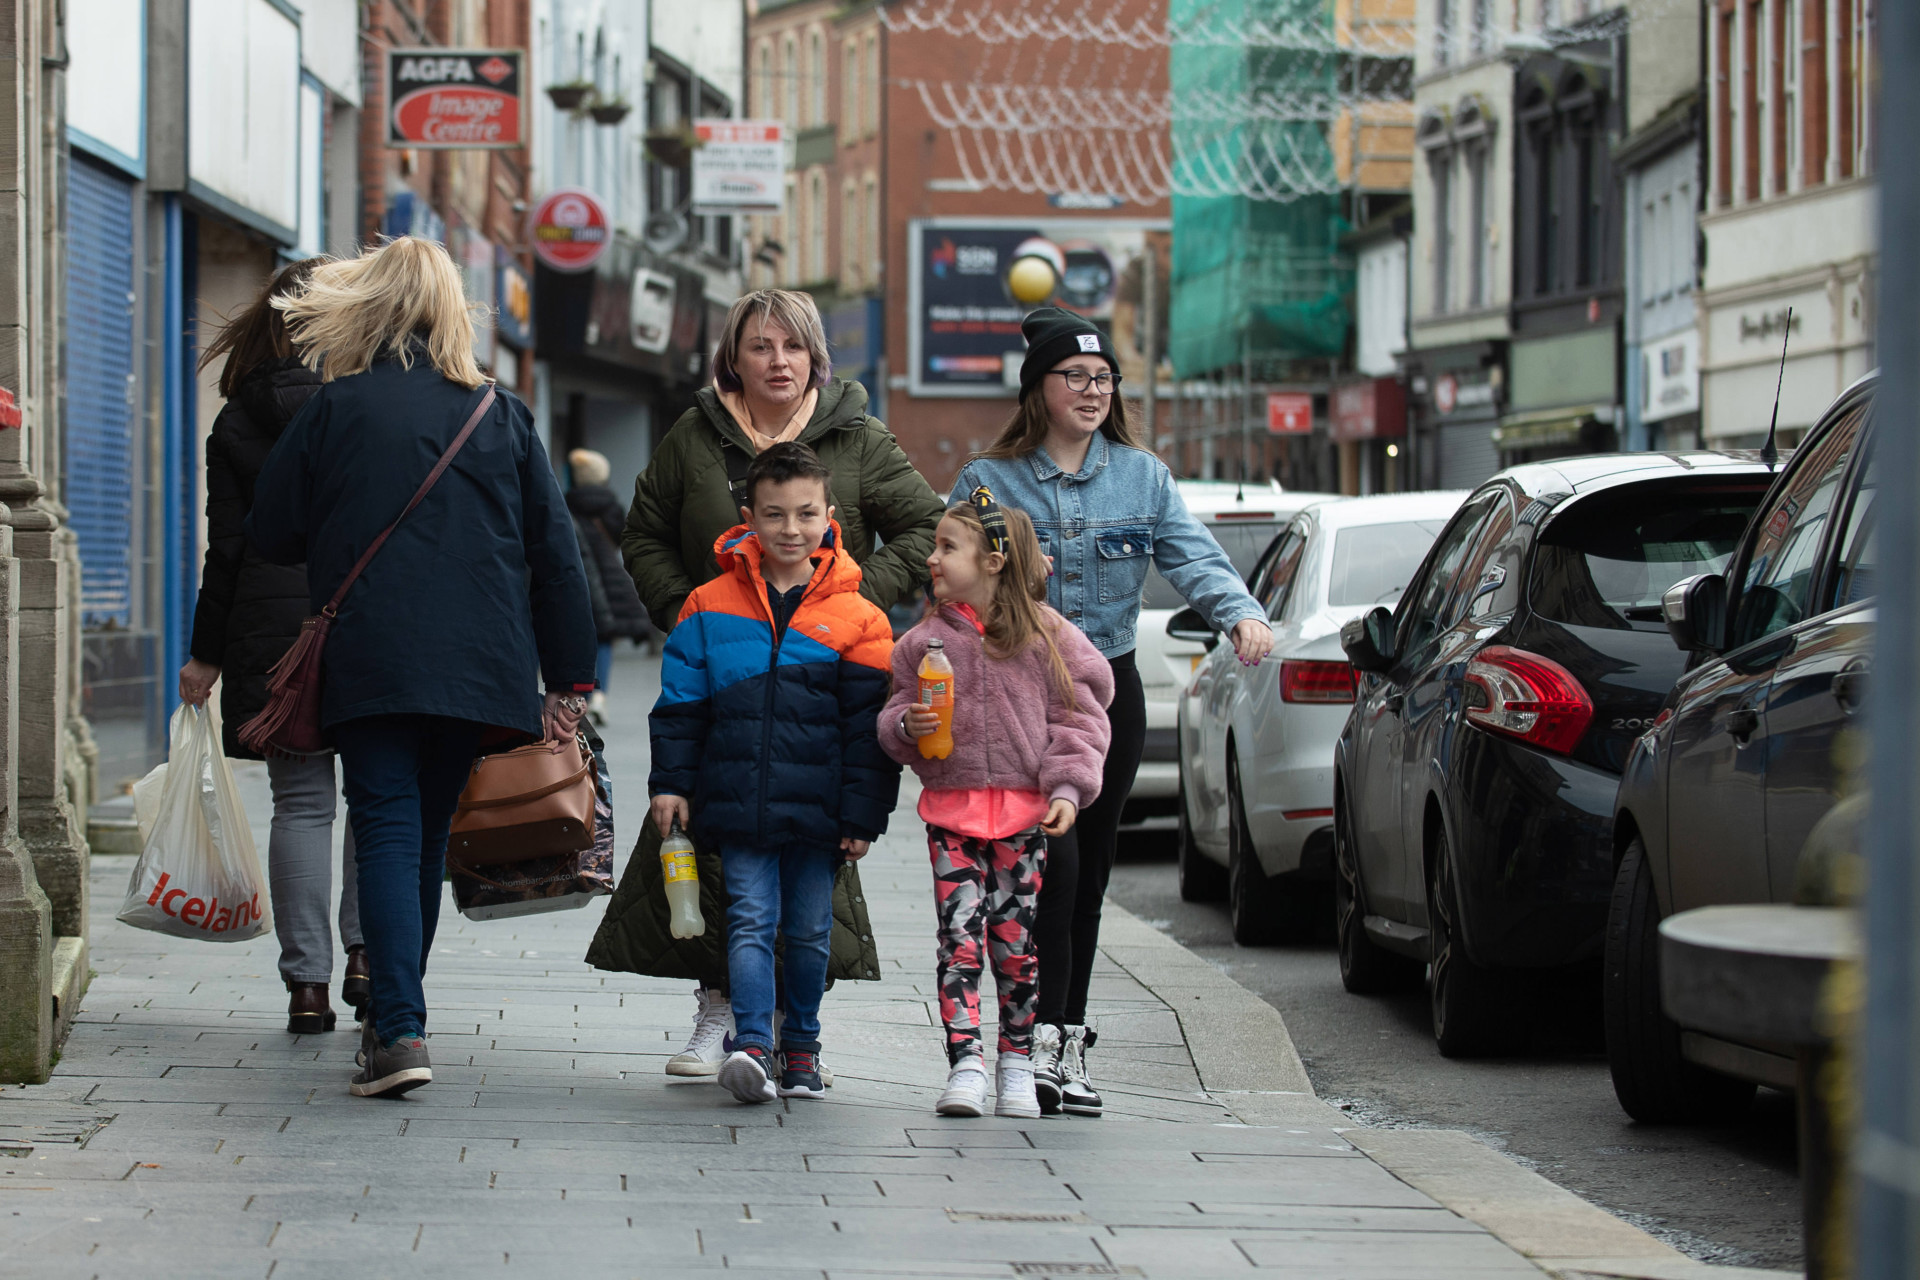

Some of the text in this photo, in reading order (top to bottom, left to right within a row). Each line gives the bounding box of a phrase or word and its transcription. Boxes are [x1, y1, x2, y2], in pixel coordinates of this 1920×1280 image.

[399, 58, 474, 81] AGFA
[429, 92, 504, 124] Image
[422, 117, 501, 141] Centre
